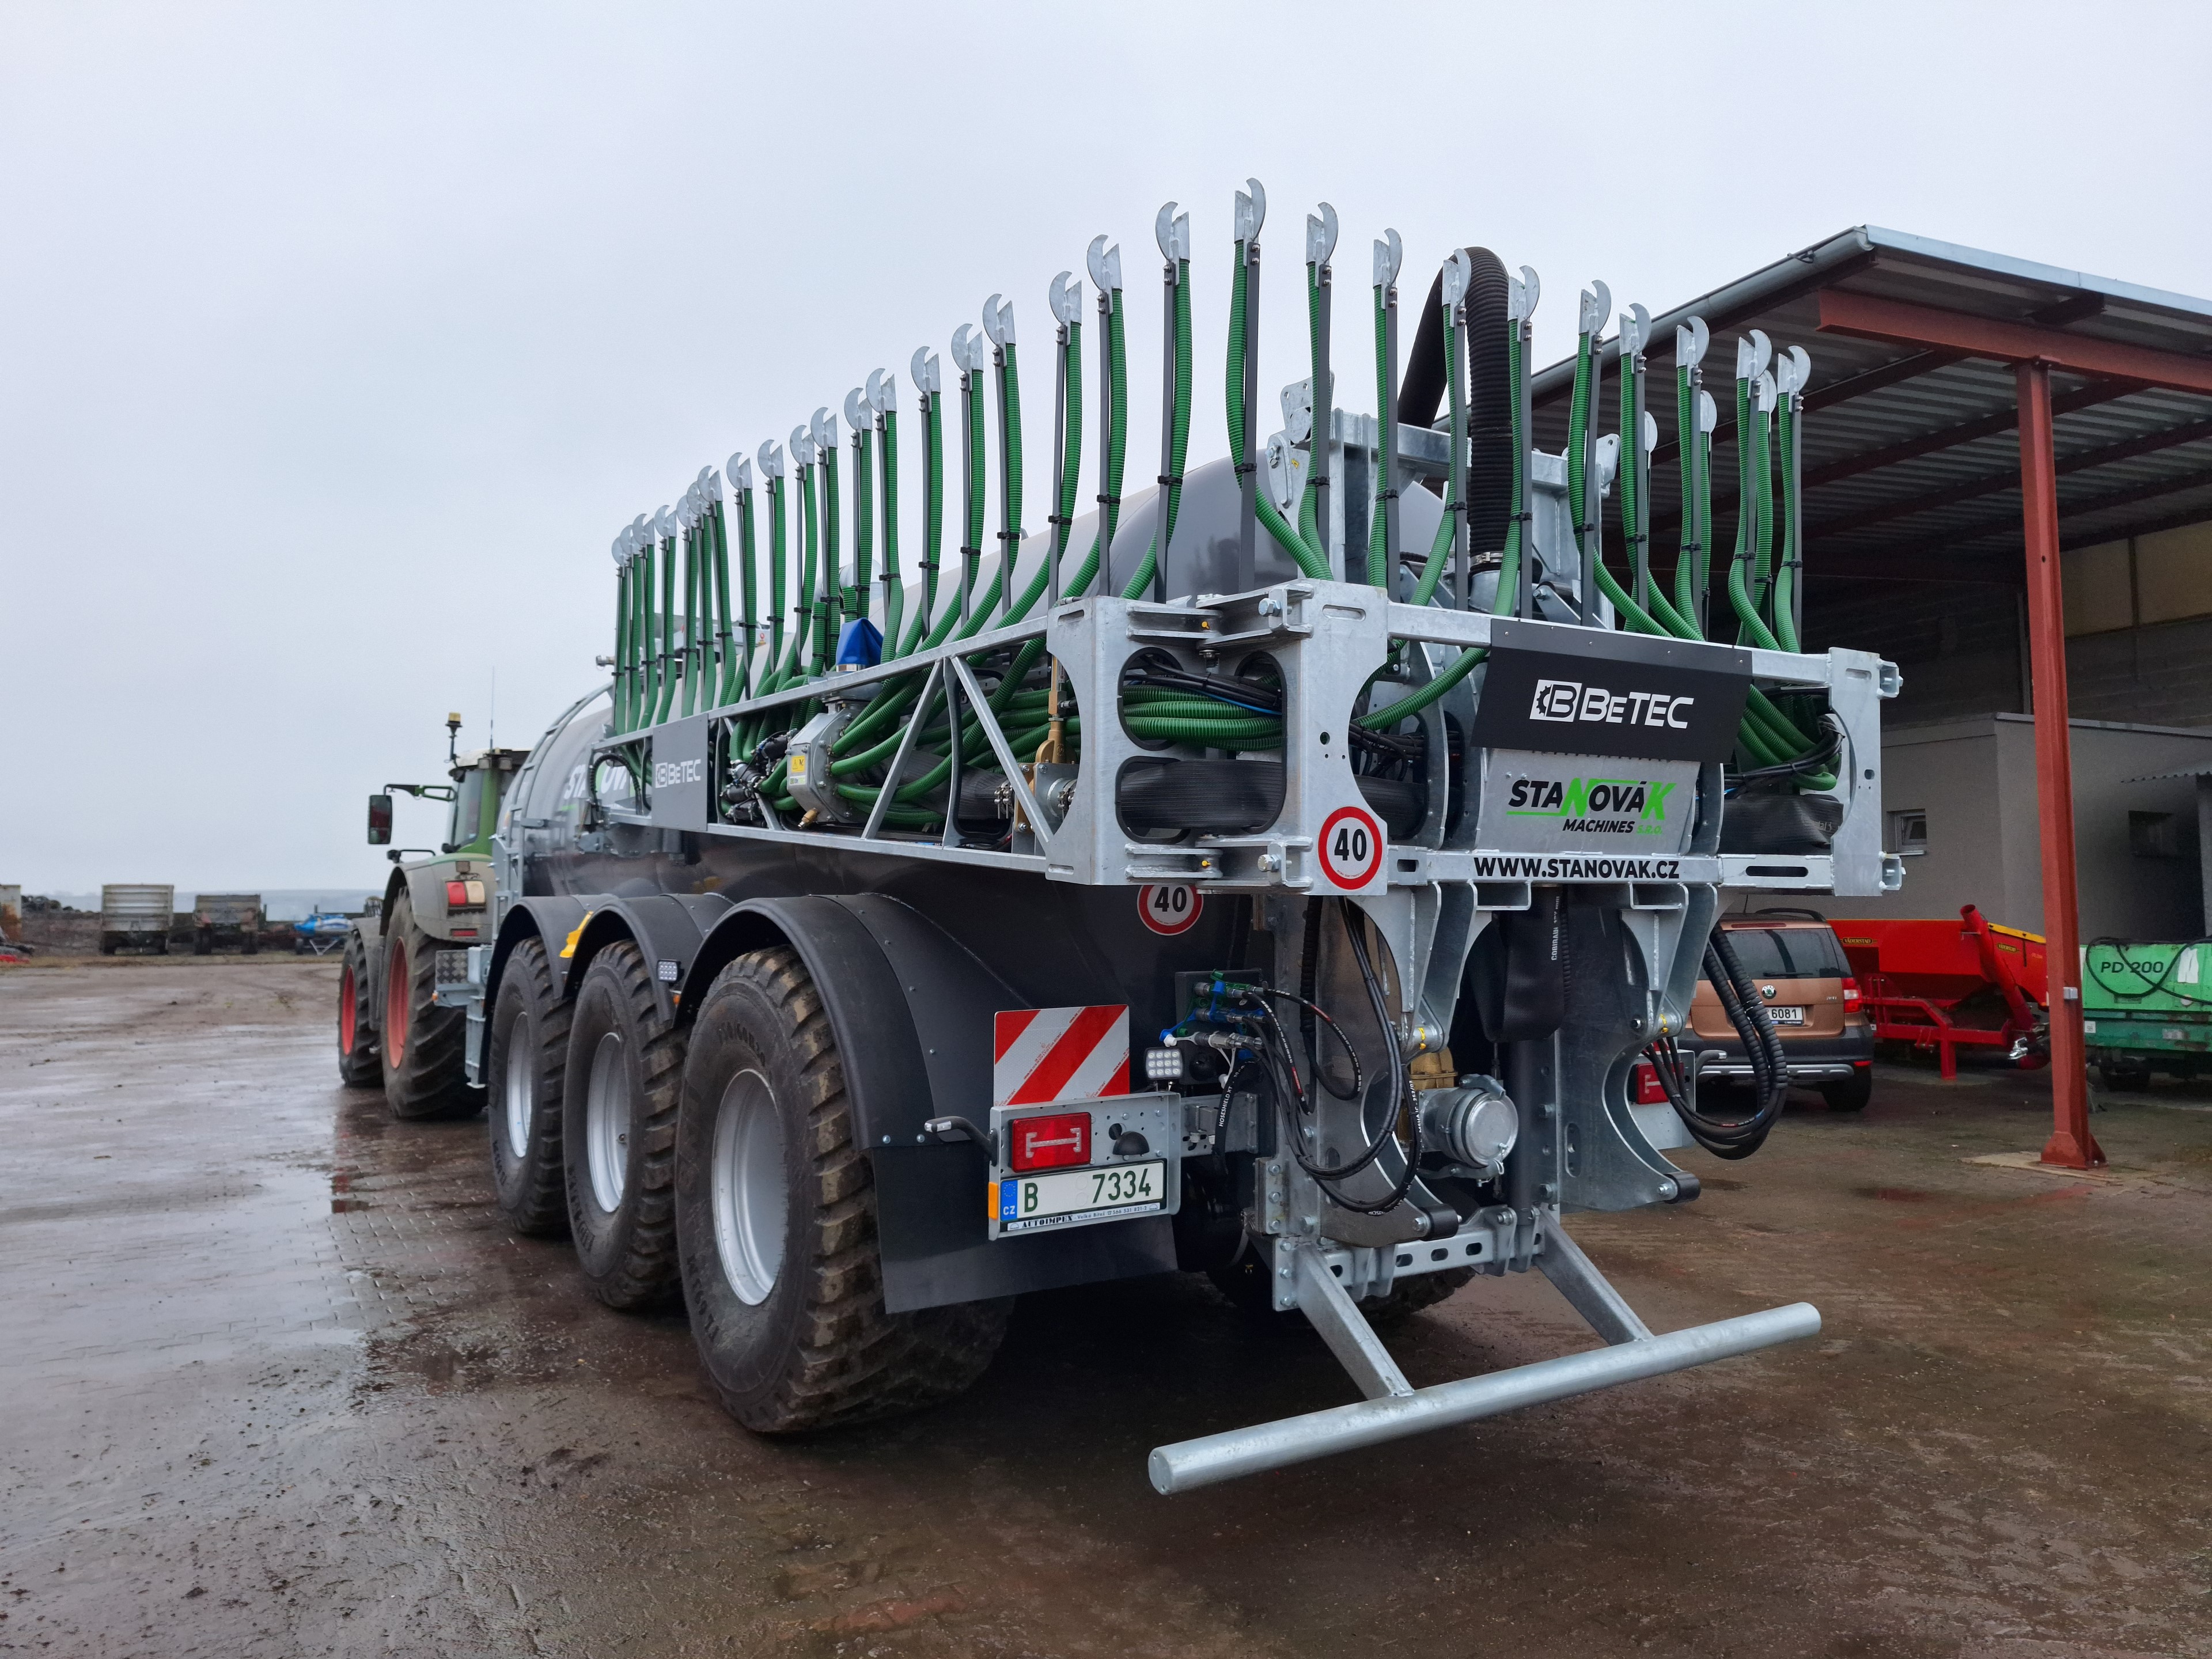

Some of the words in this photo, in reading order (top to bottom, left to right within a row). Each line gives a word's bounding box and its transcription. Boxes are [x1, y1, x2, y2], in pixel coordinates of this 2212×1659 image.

[1508, 777, 1677, 820] STANOVÁK
[1562, 819, 1635, 833] MACHINES
[1334, 828, 1367, 862] 40
[1474, 857, 1680, 878] WWW.STANOVAK.CZ
[1154, 887, 1187, 912] 40
[2100, 961, 2124, 973] PD
[2130, 961, 2164, 973] 200
[1771, 1009, 1797, 1019] 6081
[1218, 1094, 1230, 1127] HOSESHIELD
[1024, 1182, 1038, 1213] B
[1092, 1168, 1151, 1204] 7334
[1003, 1205, 1016, 1215] CZ
[1022, 1215, 1073, 1228] AUTOIMPEX
